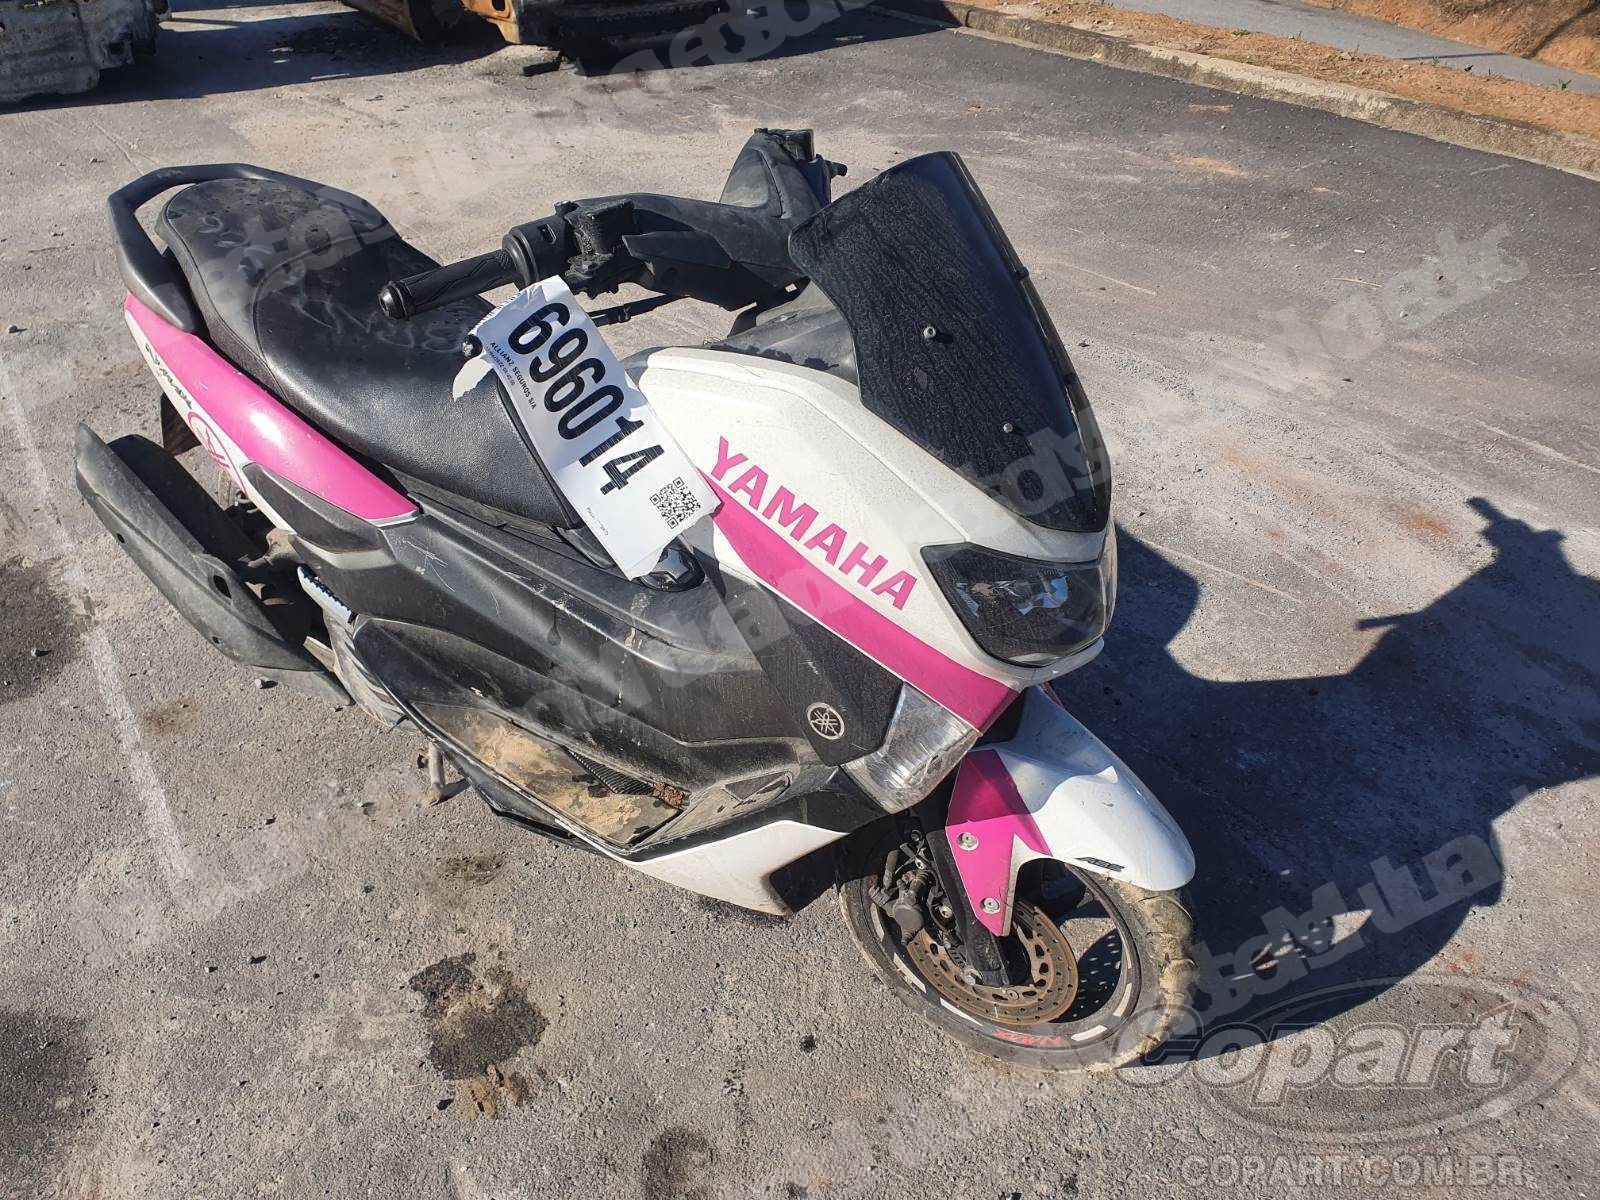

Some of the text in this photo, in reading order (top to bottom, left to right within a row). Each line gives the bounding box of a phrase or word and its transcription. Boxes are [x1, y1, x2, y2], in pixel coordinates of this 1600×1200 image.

[489, 341, 515, 366] ALLIANZ
[512, 366, 531, 397] SEGUROS
[508, 302, 664, 495] 696014
[710, 435, 918, 610] YAMAHA
